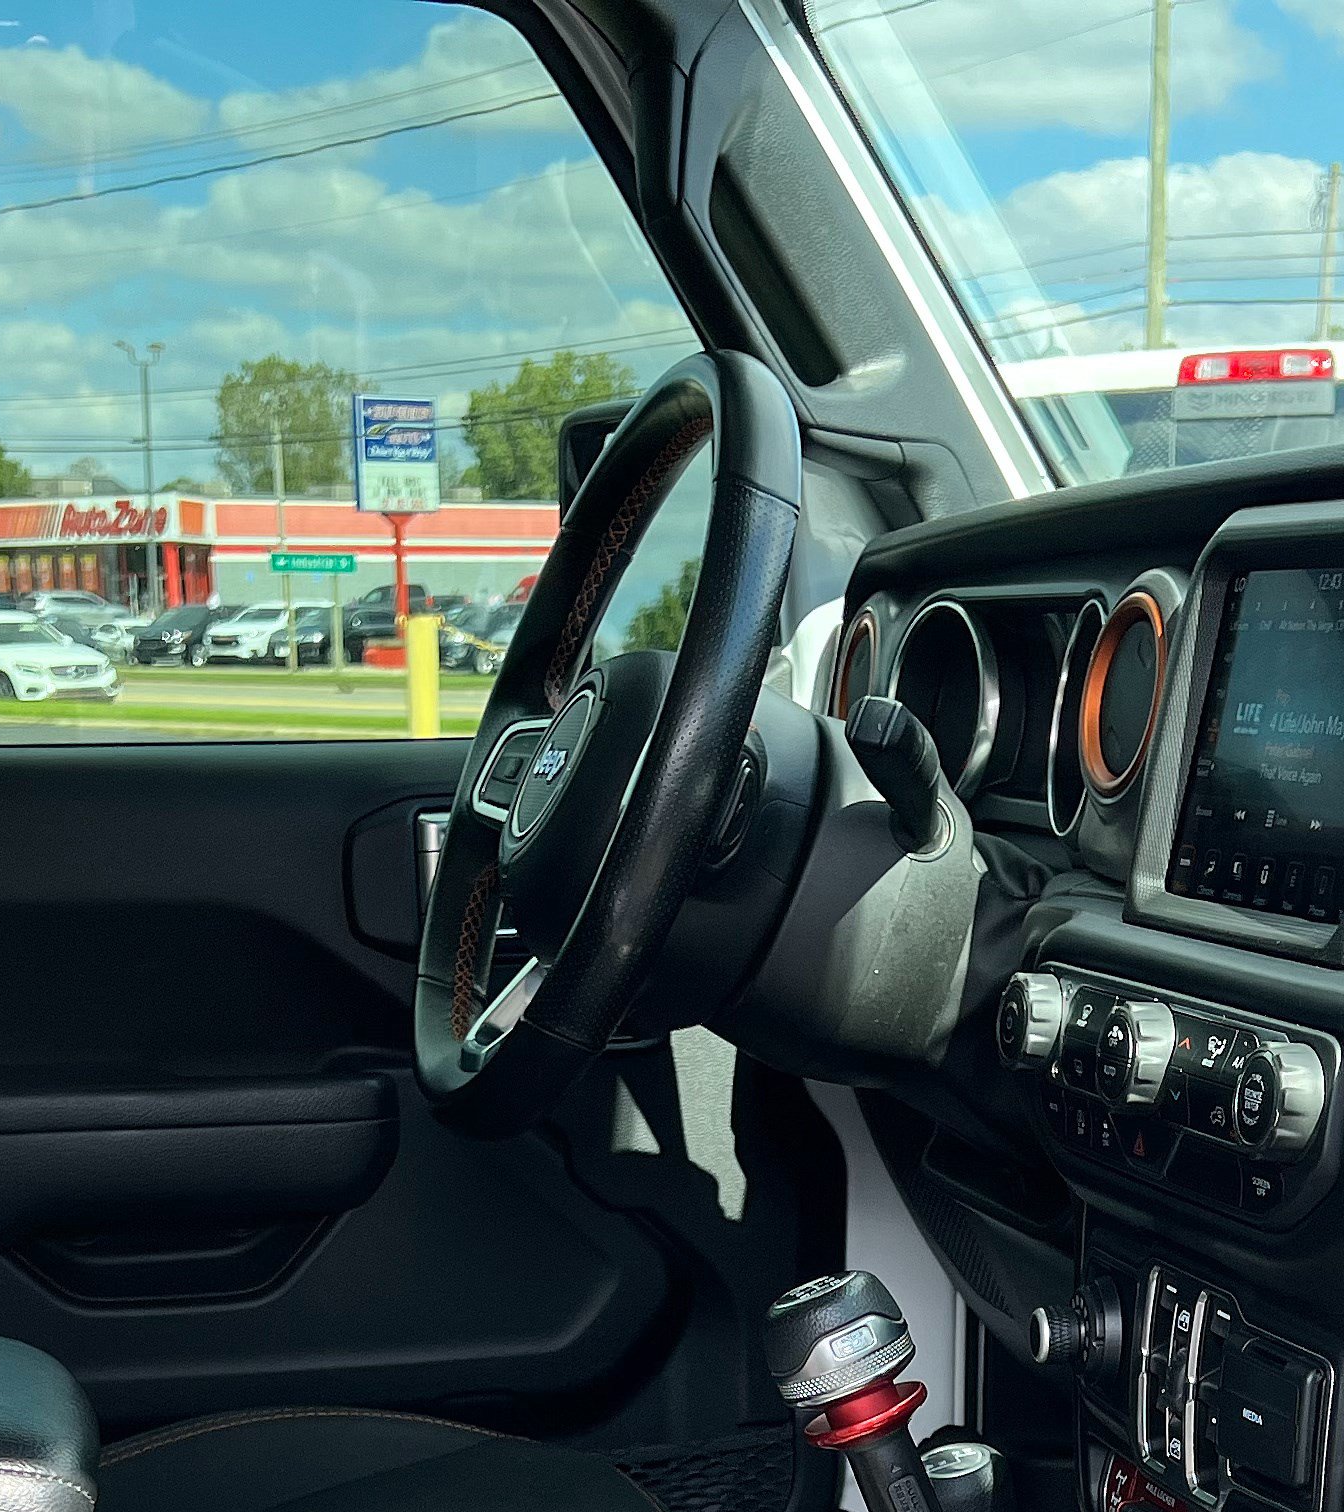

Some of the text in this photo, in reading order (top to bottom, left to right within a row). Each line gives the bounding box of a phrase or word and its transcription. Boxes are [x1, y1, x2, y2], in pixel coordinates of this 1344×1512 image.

[59, 499, 168, 538] AutoZone
[1236, 702, 1264, 723] LIFE
[533, 742, 568, 781] Jeep
[1260, 763, 1324, 786] That Voice Again
[1242, 1407, 1263, 1426] MEDIA
